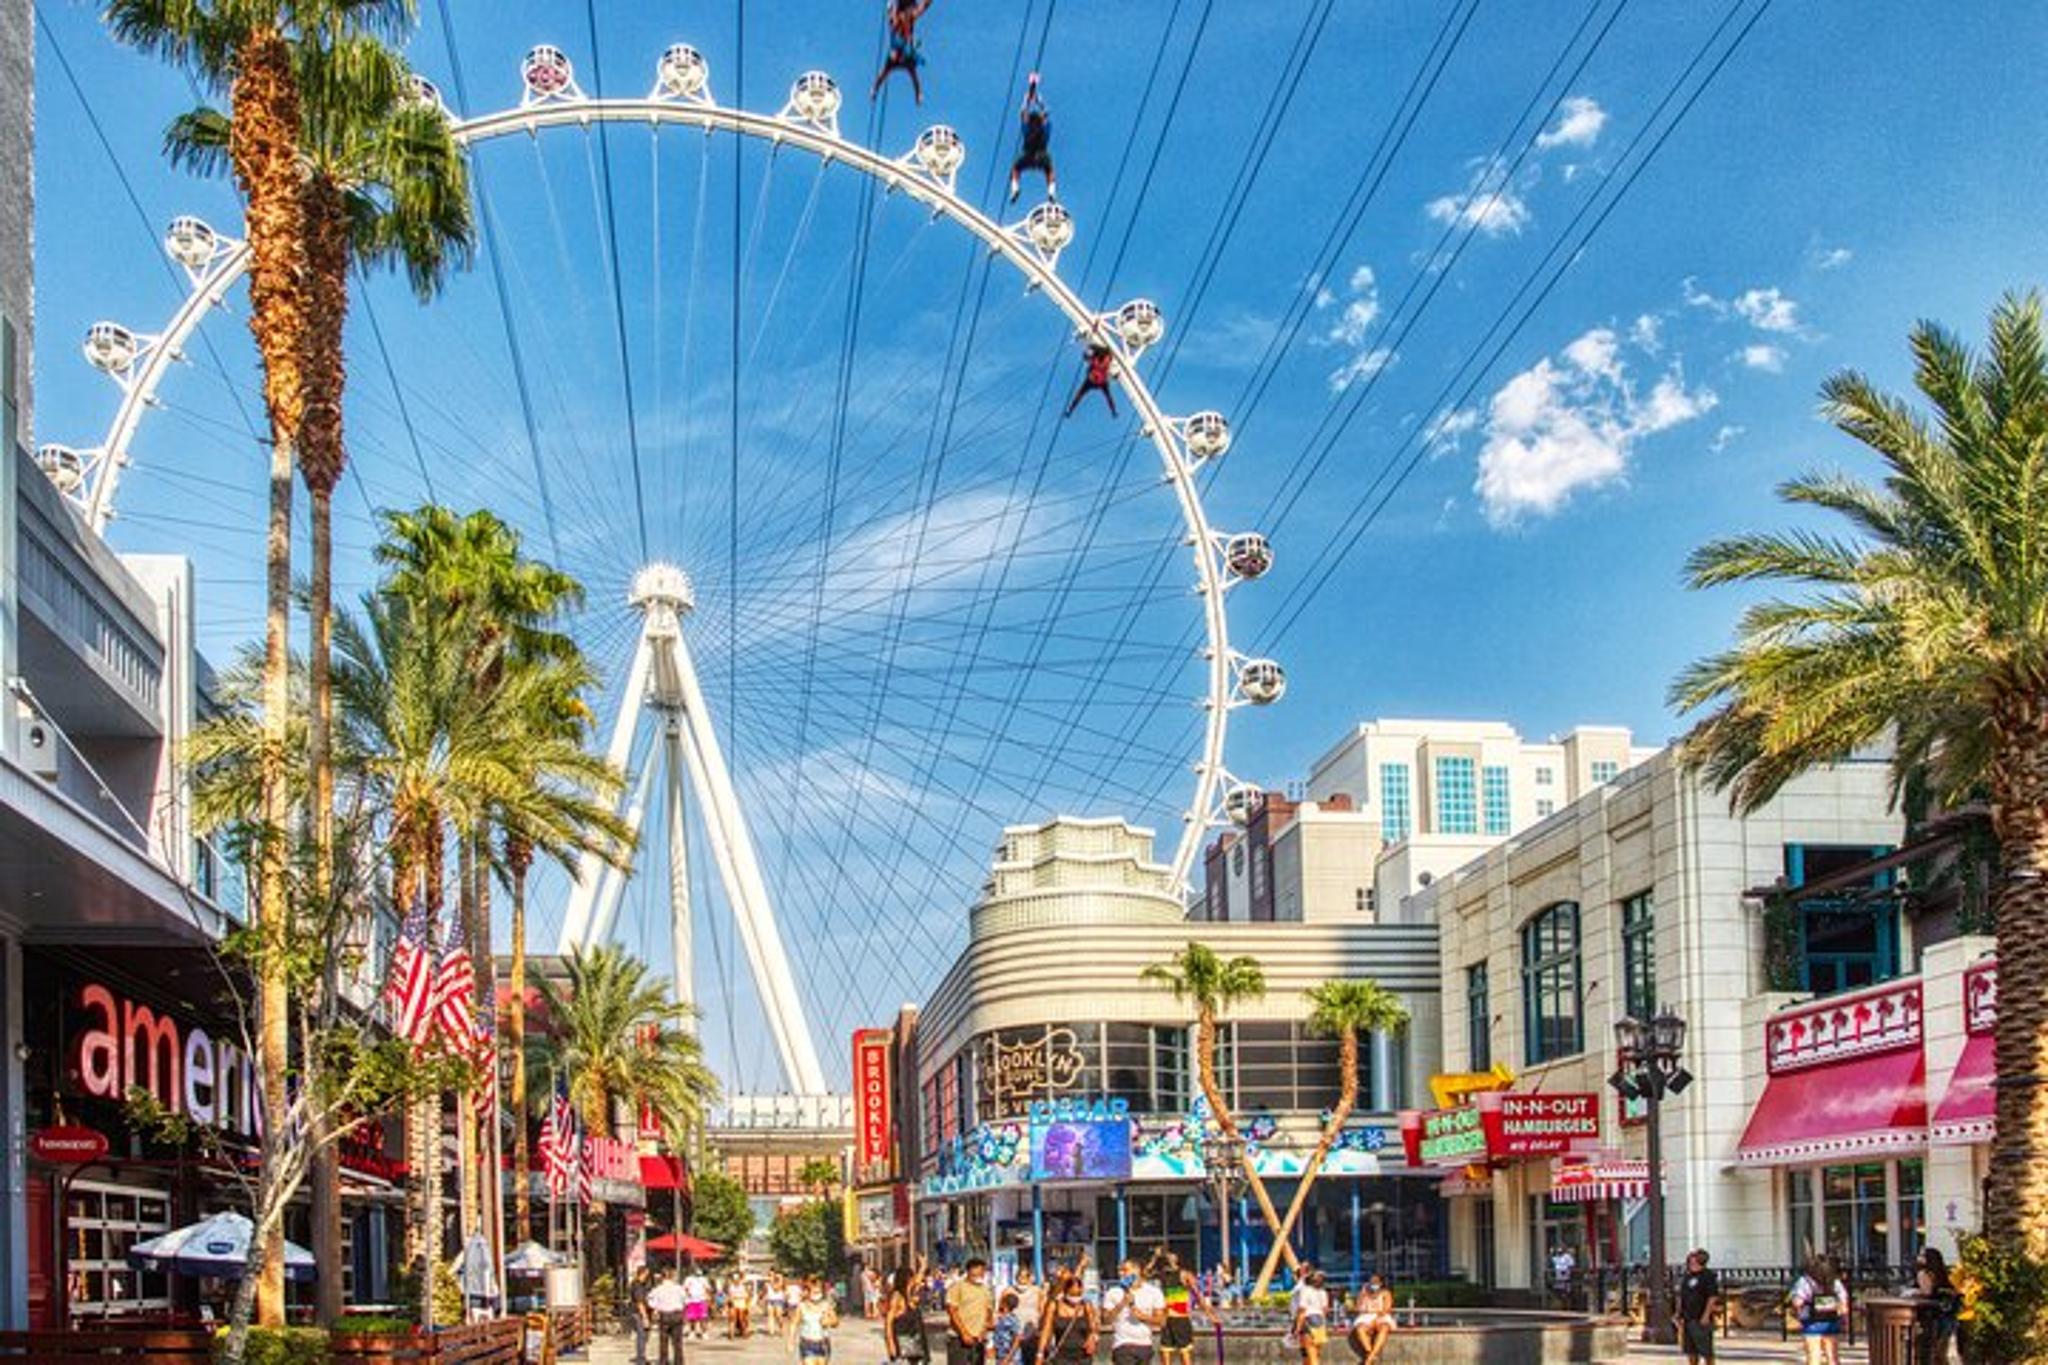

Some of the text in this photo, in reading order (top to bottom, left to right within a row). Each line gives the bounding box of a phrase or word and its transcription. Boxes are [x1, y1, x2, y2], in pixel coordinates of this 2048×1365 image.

[866, 1050, 883, 1164] BROOKLYN
[1503, 1098, 1587, 1116] IN-N-OUT
[1503, 1117, 1597, 1136] HAMBURGERS
